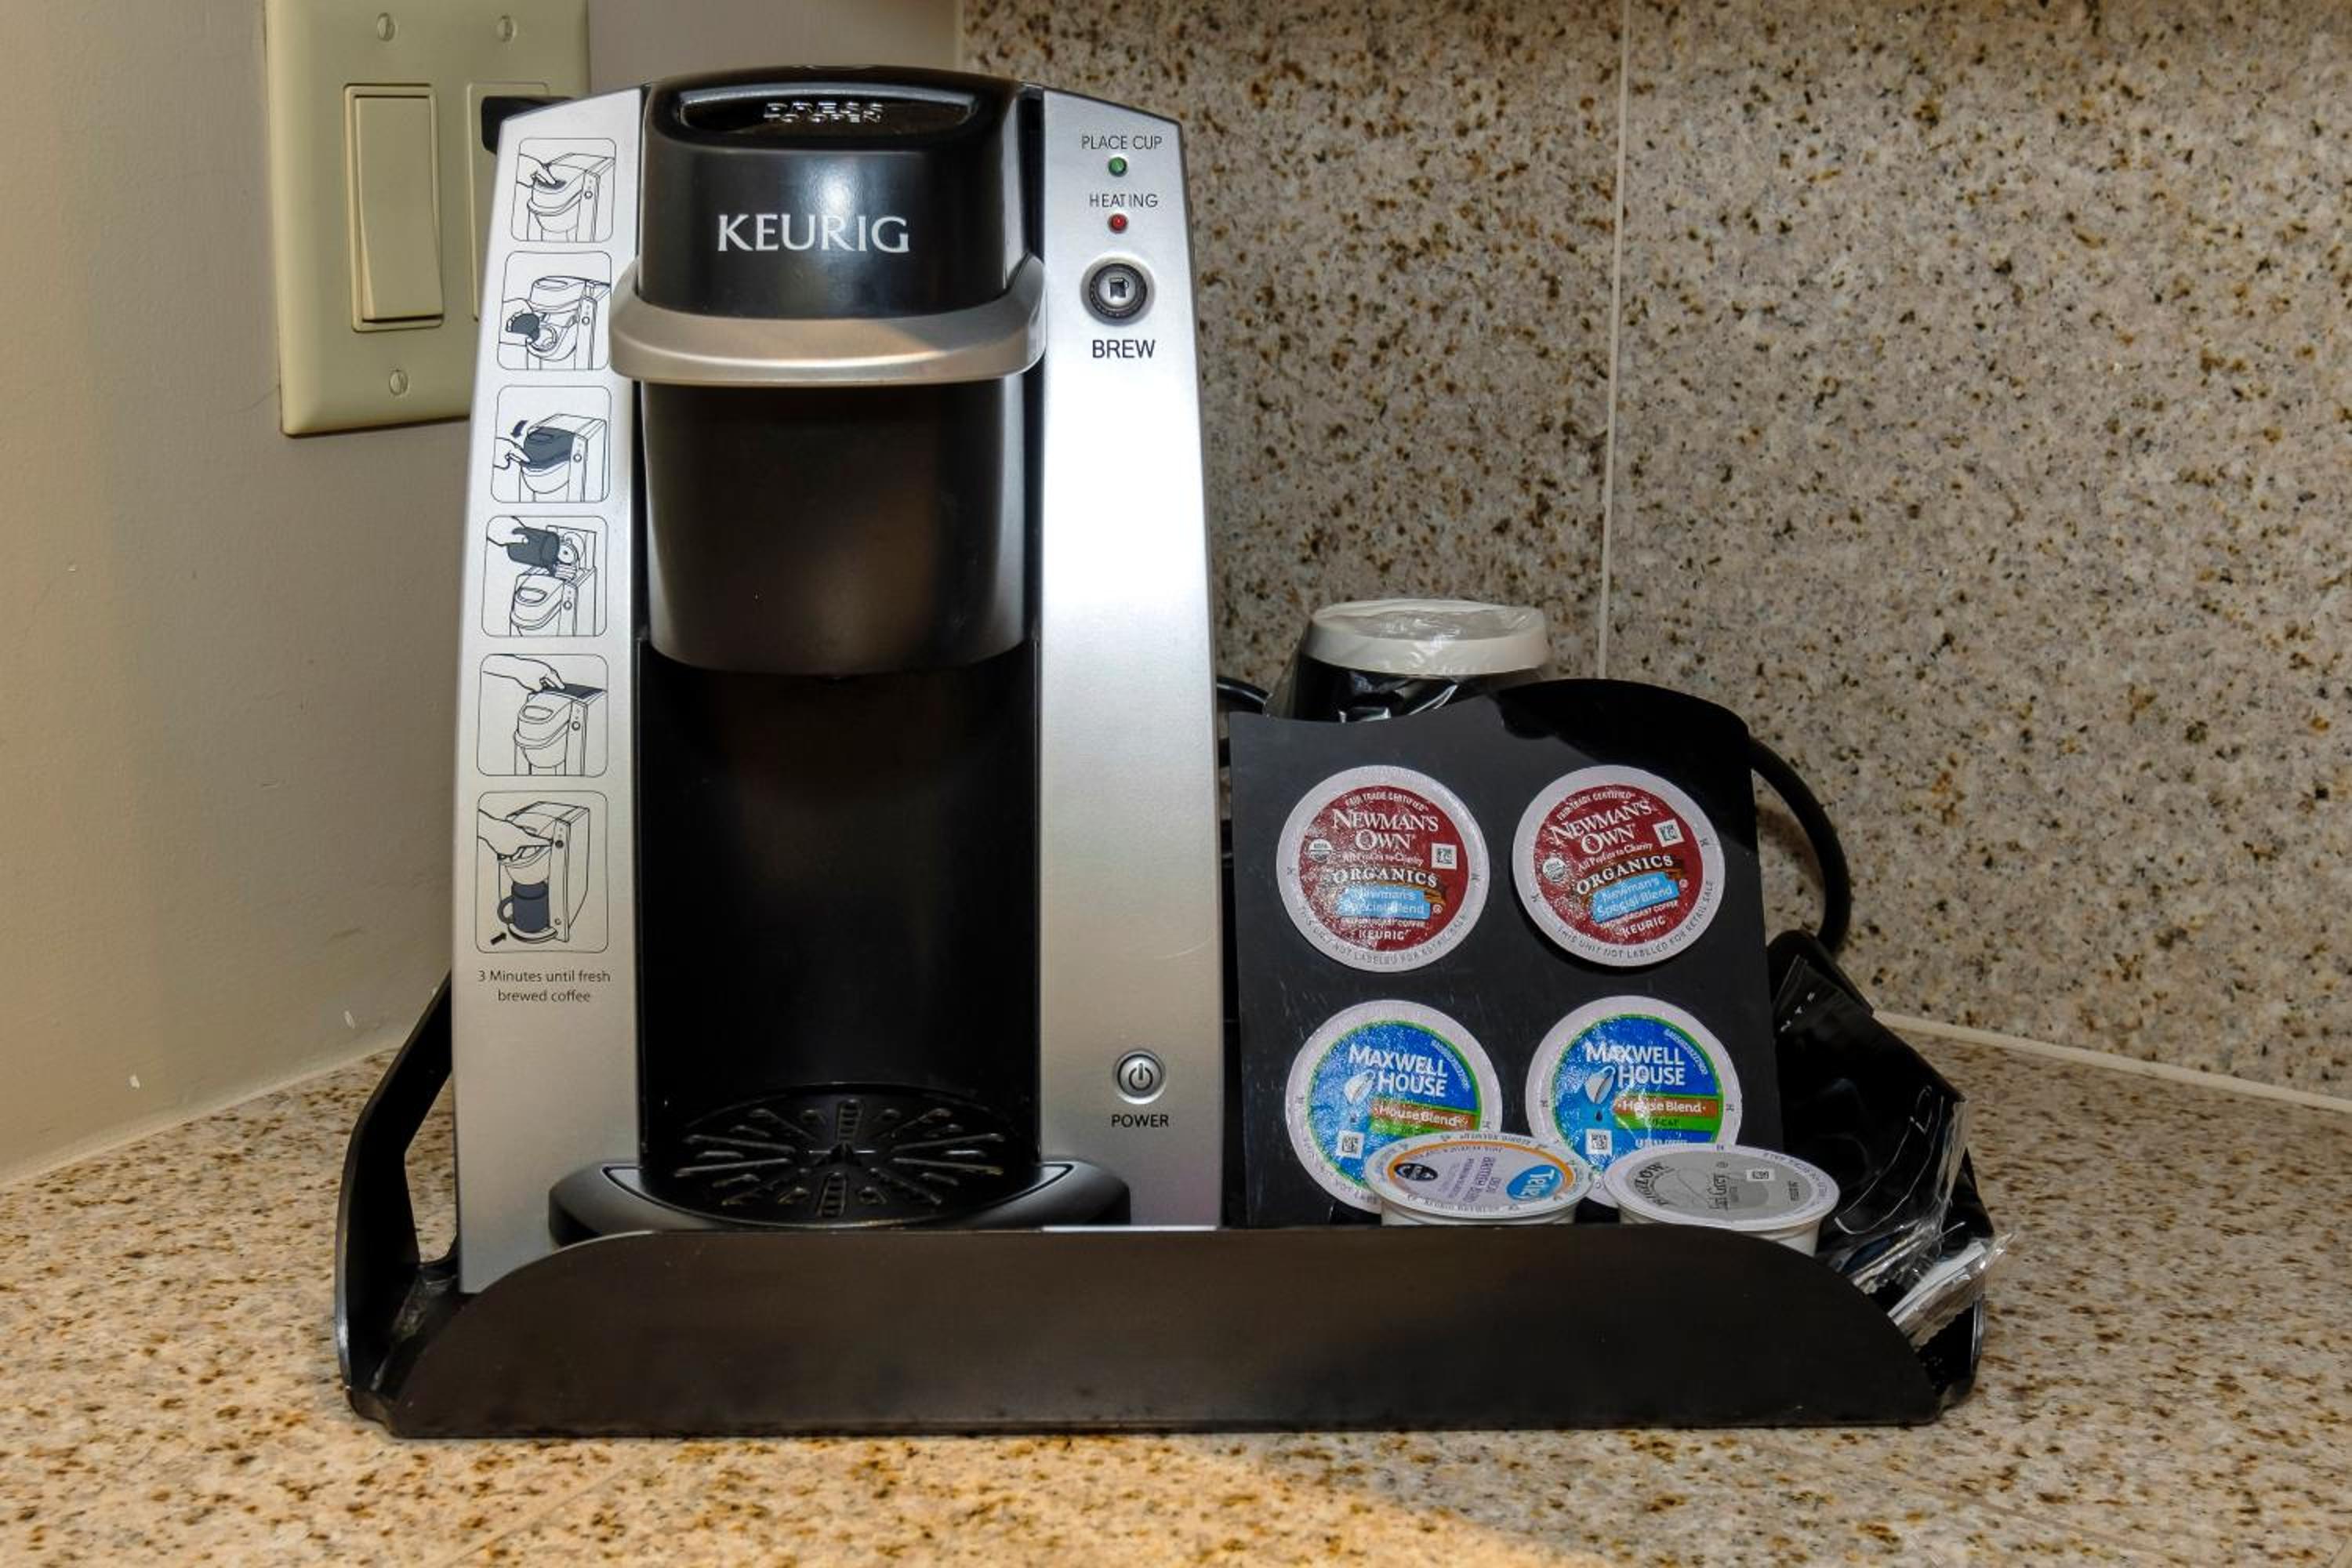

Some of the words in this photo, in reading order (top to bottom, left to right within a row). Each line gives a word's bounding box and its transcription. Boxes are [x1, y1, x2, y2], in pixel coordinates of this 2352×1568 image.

[1081, 136, 1127, 150] PLACE
[1133, 136, 1163, 150] CUP
[1090, 193, 1158, 209] HEATING
[717, 212, 910, 253] KEURIG
[1092, 339, 1156, 359] BREW
[1332, 808, 1439, 832] NEWMAN'S
[1548, 798, 1652, 846] NEWMAN'S
[1355, 829, 1413, 851] OWN
[1580, 825, 1635, 855] OWN
[1332, 866, 1439, 888] ORGANICS
[1575, 854, 1675, 895] ORGANICS
[1359, 930, 1406, 942] KEURIG
[1621, 915, 1667, 938] KEURIG
[1603, 947, 1624, 959] NOT
[478, 970, 486, 982] 3
[490, 970, 542, 982] Minutes
[546, 970, 575, 982] until
[579, 969, 611, 982] fresh
[498, 989, 547, 1001] brewed
[550, 989, 591, 1002] coffee
[1348, 1044, 1450, 1078] MAXWELL
[1584, 1041, 1686, 1066] MAXWELL
[1377, 1070, 1447, 1098] HOUSE
[1617, 1067, 1686, 1087] HOUSE
[1379, 1105, 1419, 1123] House
[1421, 1110, 1459, 1127] Blend
[1622, 1099, 1664, 1113] House
[1665, 1099, 1702, 1113] Blend
[1111, 1114, 1169, 1127] POWER
